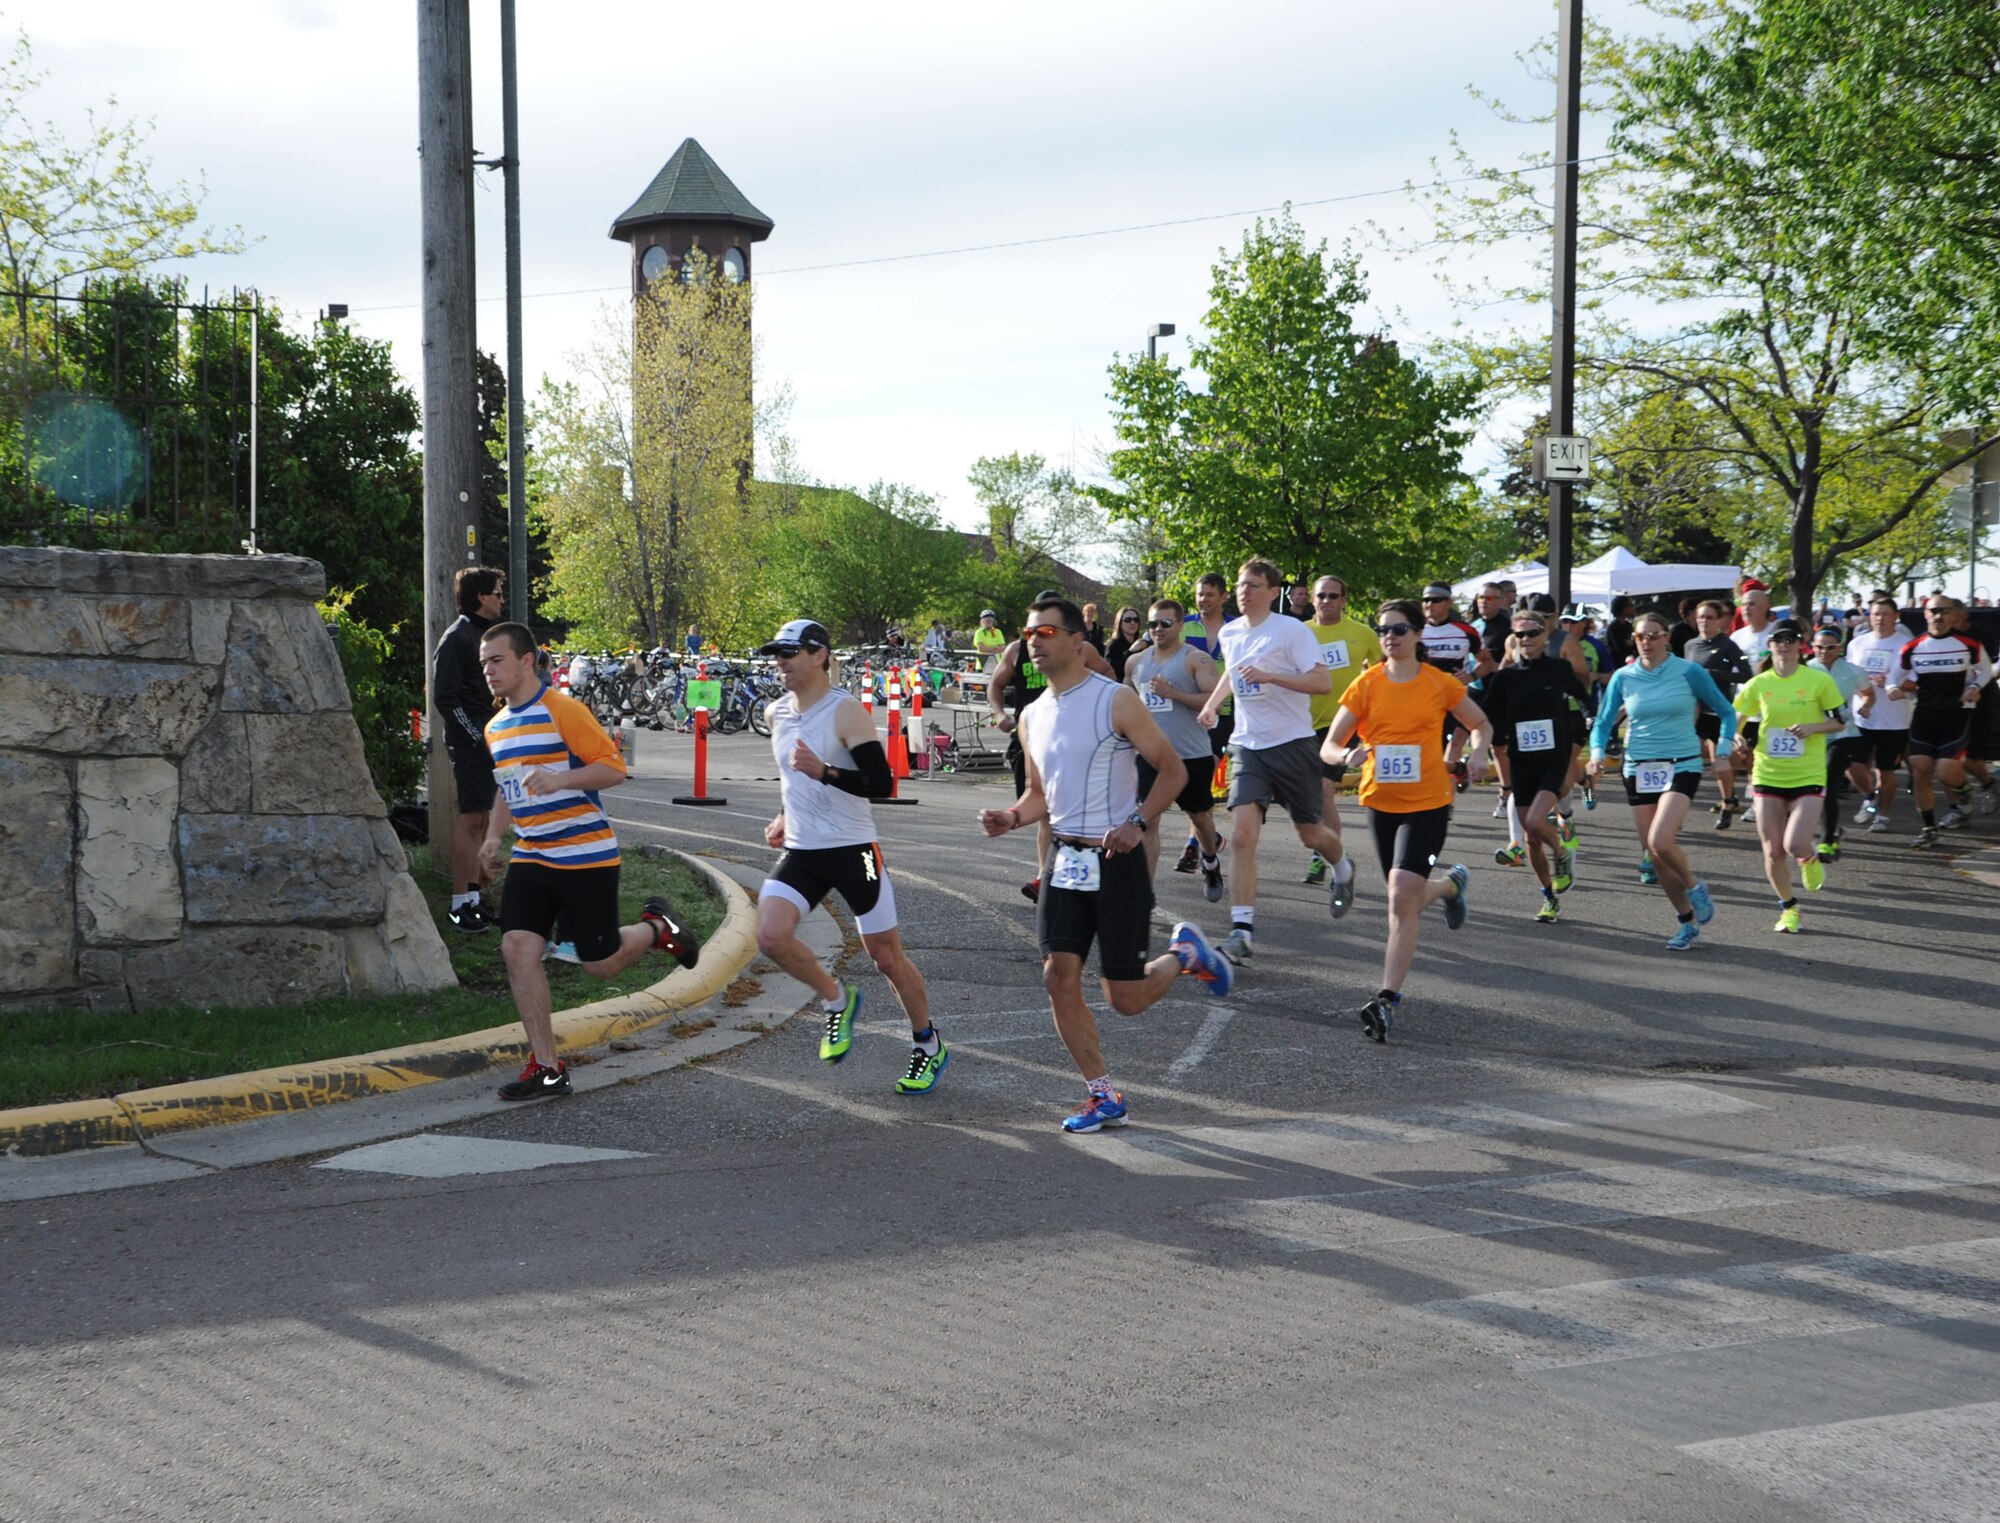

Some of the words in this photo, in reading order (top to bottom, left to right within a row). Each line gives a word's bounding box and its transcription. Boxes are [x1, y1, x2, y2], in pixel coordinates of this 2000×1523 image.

[1550, 443, 1585, 459] EXIT
[1523, 729, 1547, 745] 995
[1773, 737, 1798, 752] 952
[1382, 757, 1411, 775] 965
[1643, 770, 1668, 786] 962
